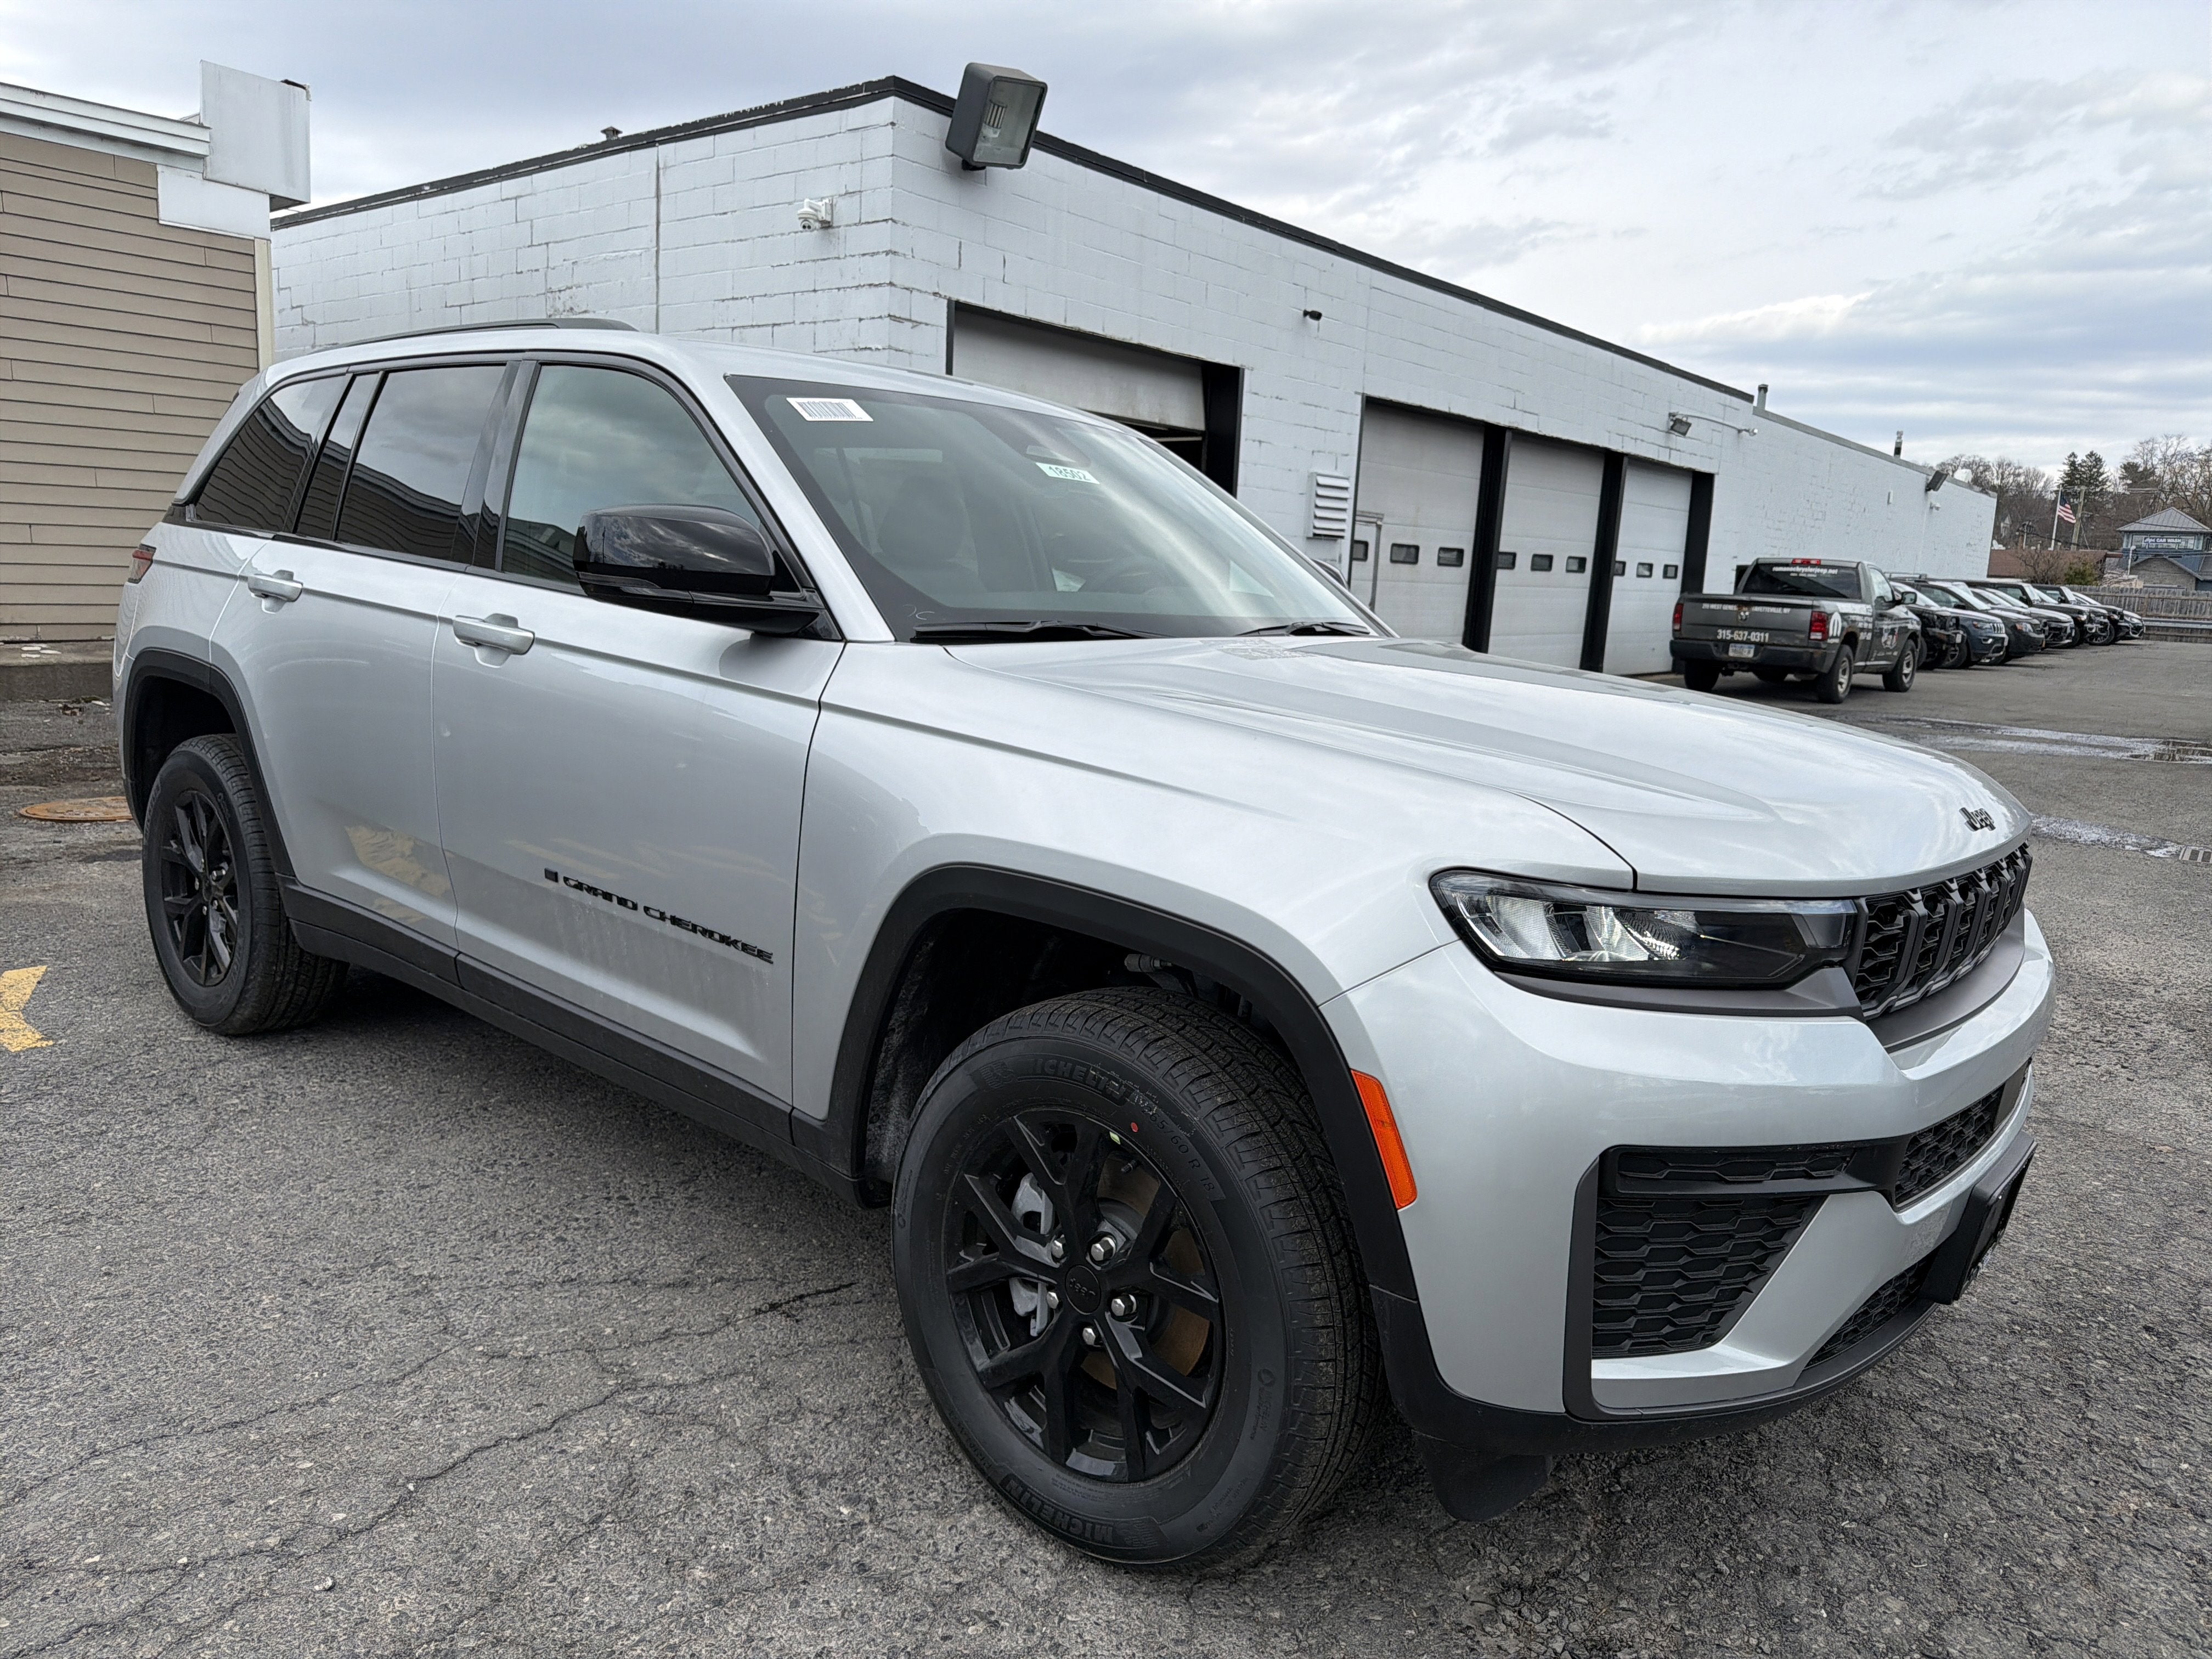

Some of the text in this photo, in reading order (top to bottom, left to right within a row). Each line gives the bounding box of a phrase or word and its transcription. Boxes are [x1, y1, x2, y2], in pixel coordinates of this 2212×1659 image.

[1049, 466, 1091, 481] 18502
[1717, 629, 1769, 642] 315-637-0311
[1959, 807, 1996, 832] Jeep
[563, 876, 774, 964] GRAND CHEROKEE
[1188, 1159, 1201, 1169] R
[1200, 1177, 1215, 1192] 18
[1005, 1479, 1113, 1544] MICHELIN
